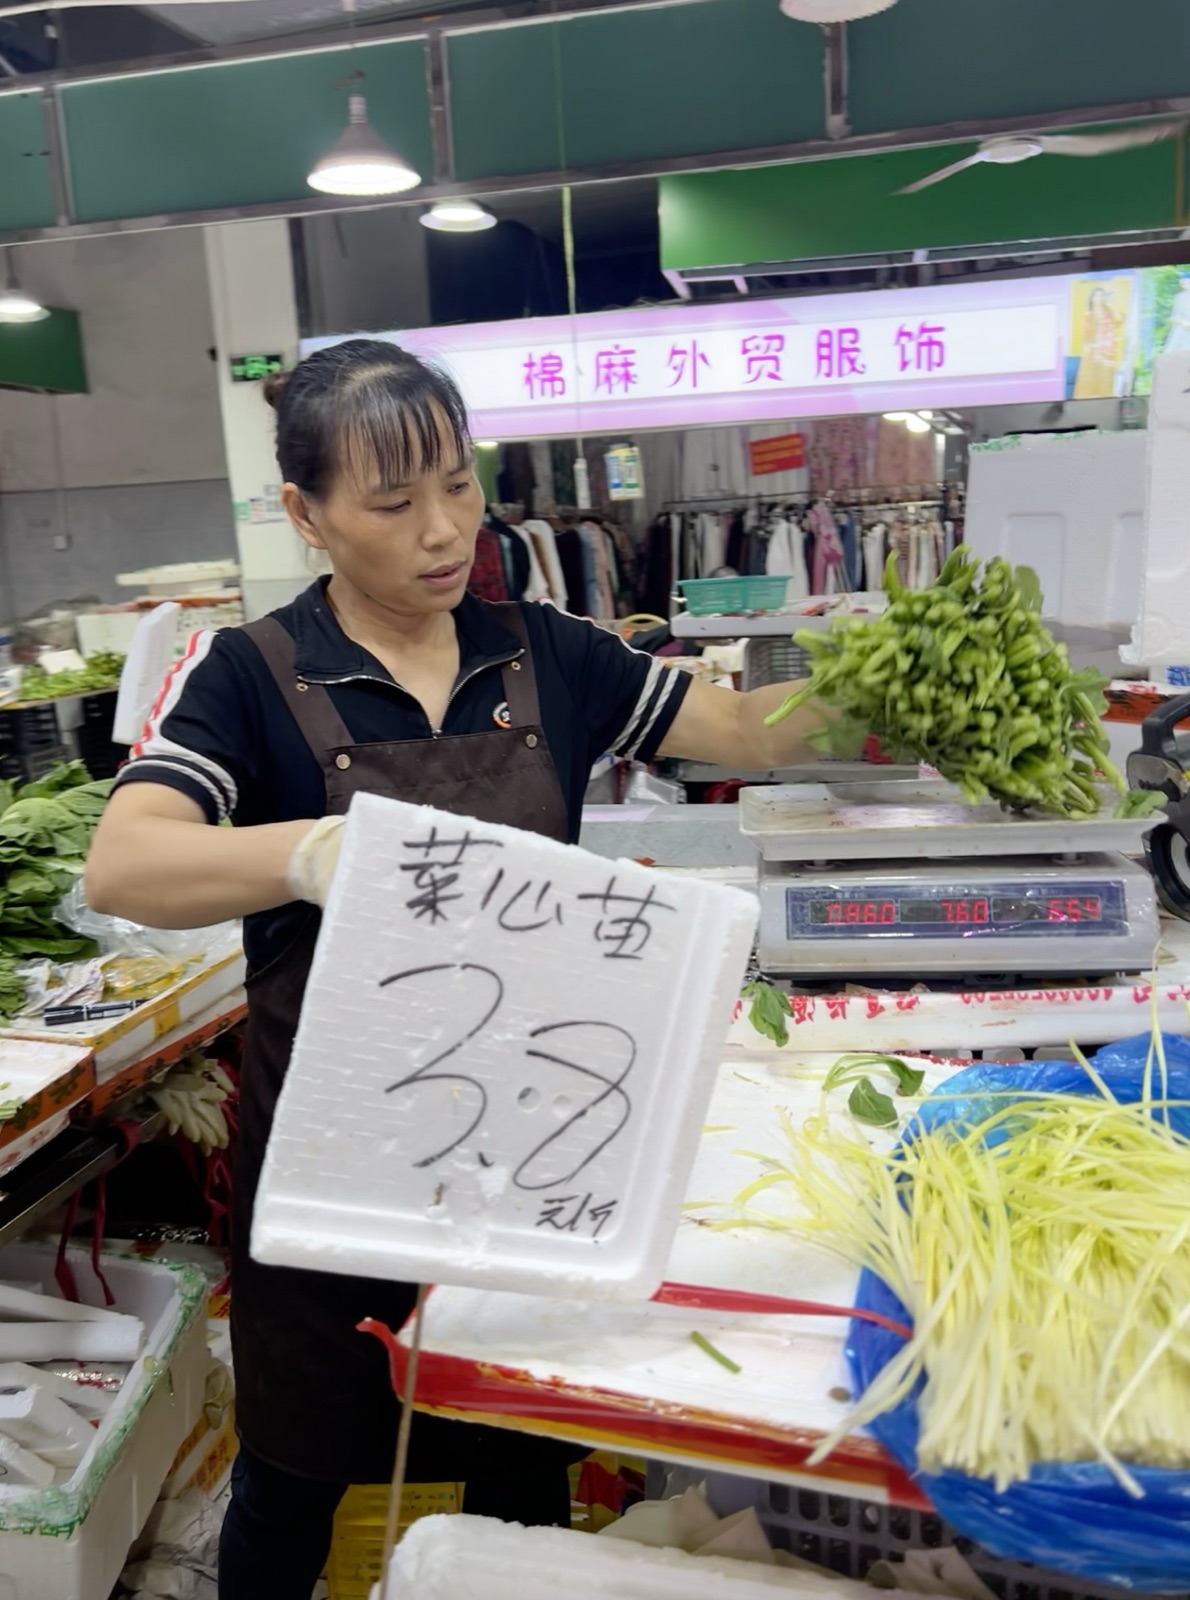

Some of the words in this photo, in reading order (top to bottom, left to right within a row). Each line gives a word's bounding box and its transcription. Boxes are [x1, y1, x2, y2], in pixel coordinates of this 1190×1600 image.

[523, 321, 946, 399] 棉麻外贸服饰
[400, 827, 677, 960] 菜心苗
[379, 963, 638, 1190] 3.8
